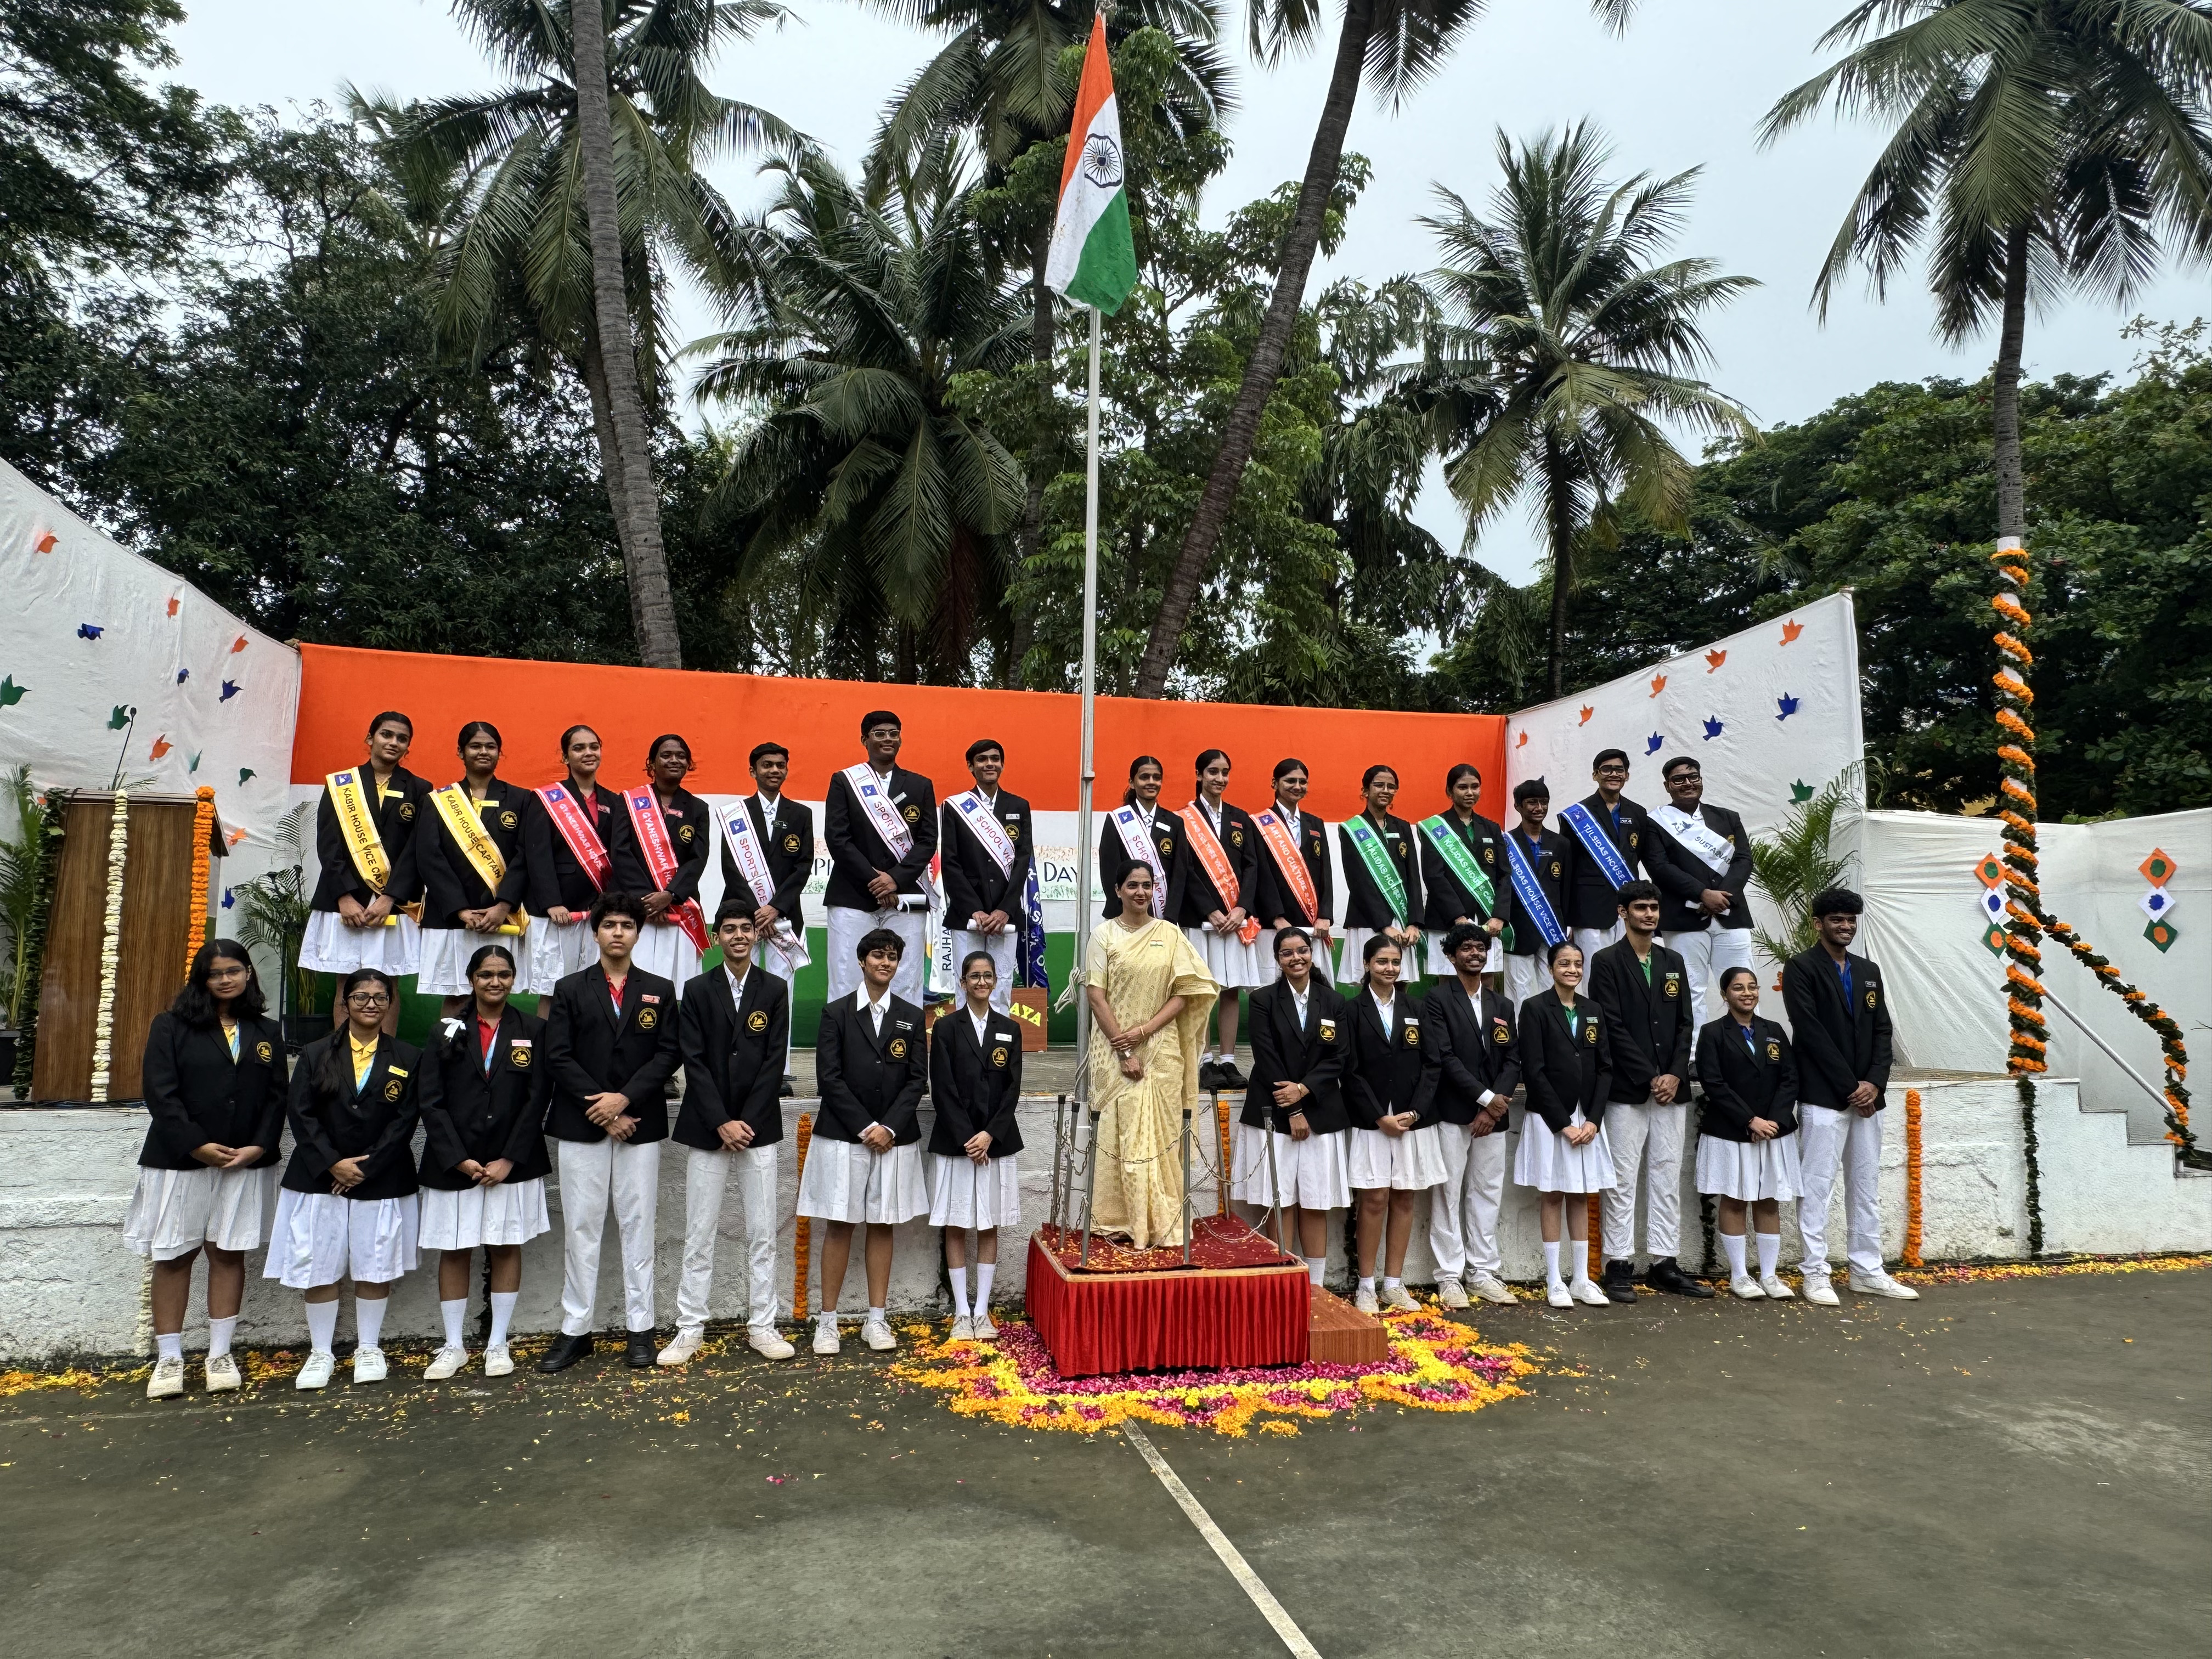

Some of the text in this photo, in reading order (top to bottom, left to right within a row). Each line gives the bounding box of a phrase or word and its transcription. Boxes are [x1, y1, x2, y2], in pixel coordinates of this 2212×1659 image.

[343, 787, 356, 813] KABIR
[350, 814, 368, 844] HOUSE
[446, 794, 502, 879] KABIR HOUSE CAPTAIN
[977, 815, 1003, 849] SCHOOL
[740, 838, 768, 902] SPORTS VICE
[1043, 862, 1077, 883] DAY
[1278, 839, 1290, 856] AND
[1583, 823, 1626, 880] TULSIDAS HOUSE
[1508, 851, 1528, 885] TULSIDAS
[1525, 884, 1543, 911] HOUSE
[1540, 910, 1552, 929] VICE
